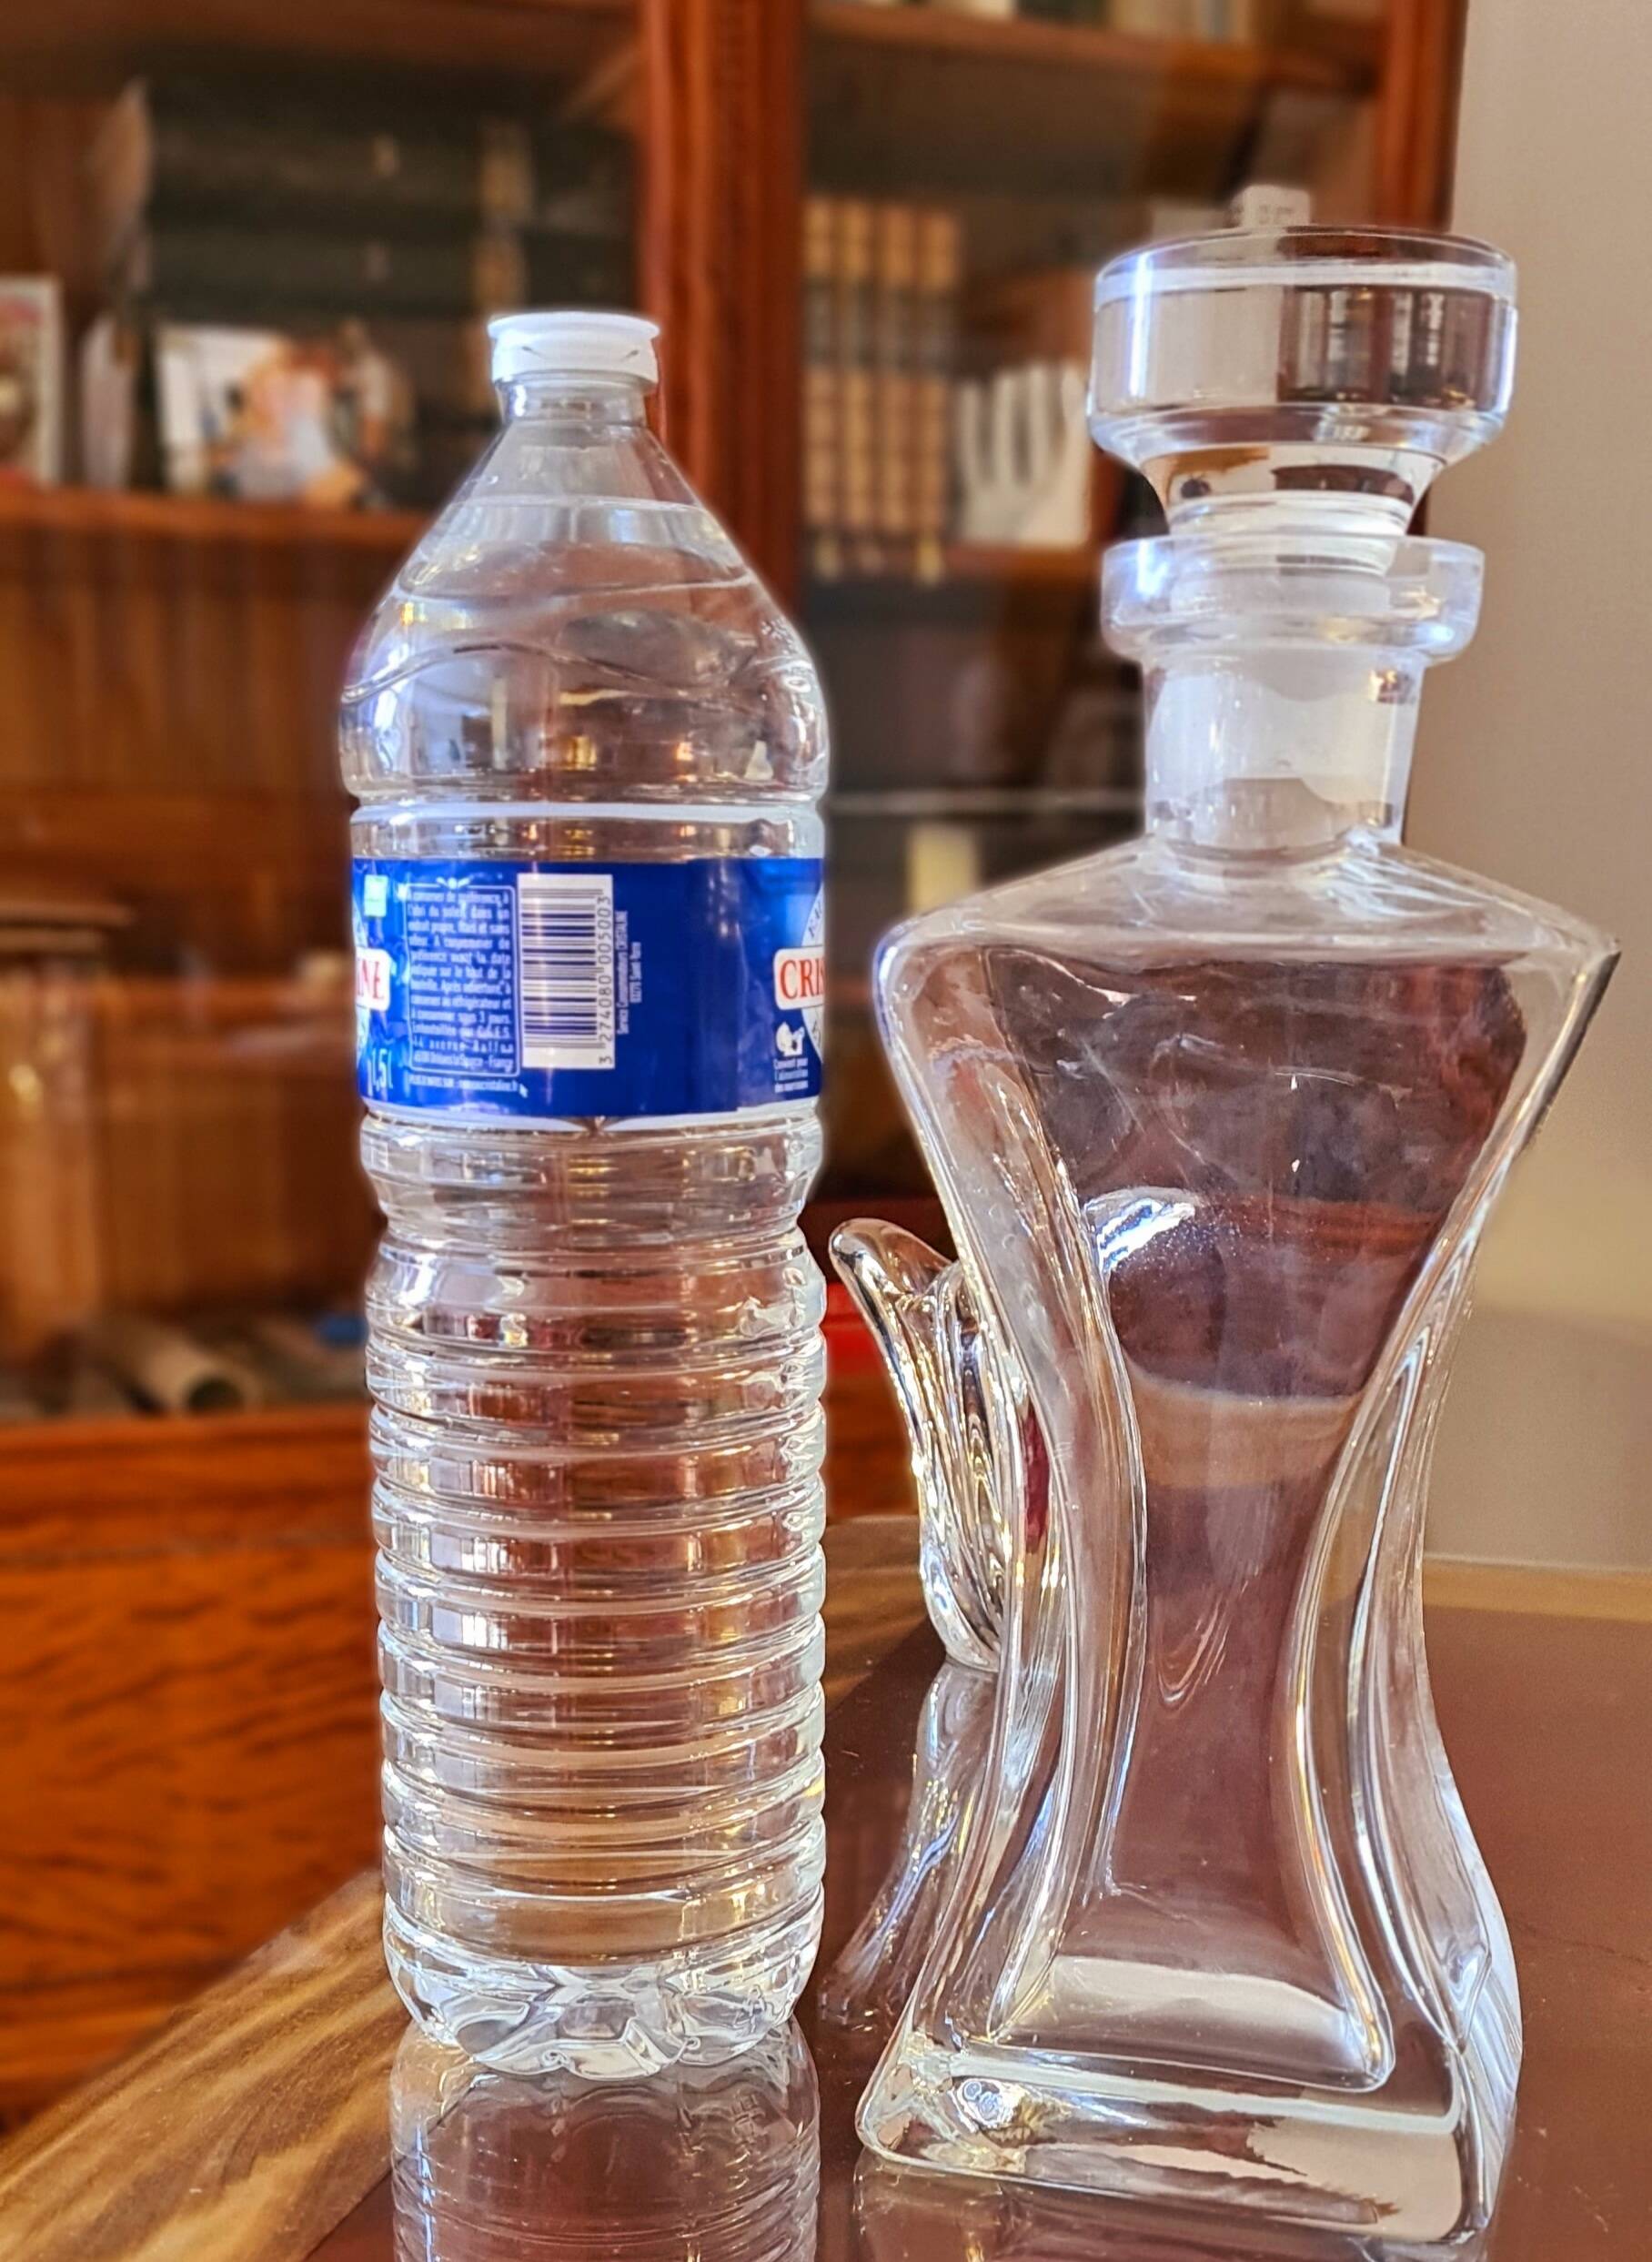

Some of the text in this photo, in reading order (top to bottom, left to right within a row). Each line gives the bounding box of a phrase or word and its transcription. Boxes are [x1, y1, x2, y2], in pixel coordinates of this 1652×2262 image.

[597, 896, 612, 1065] 3 274080 005003
